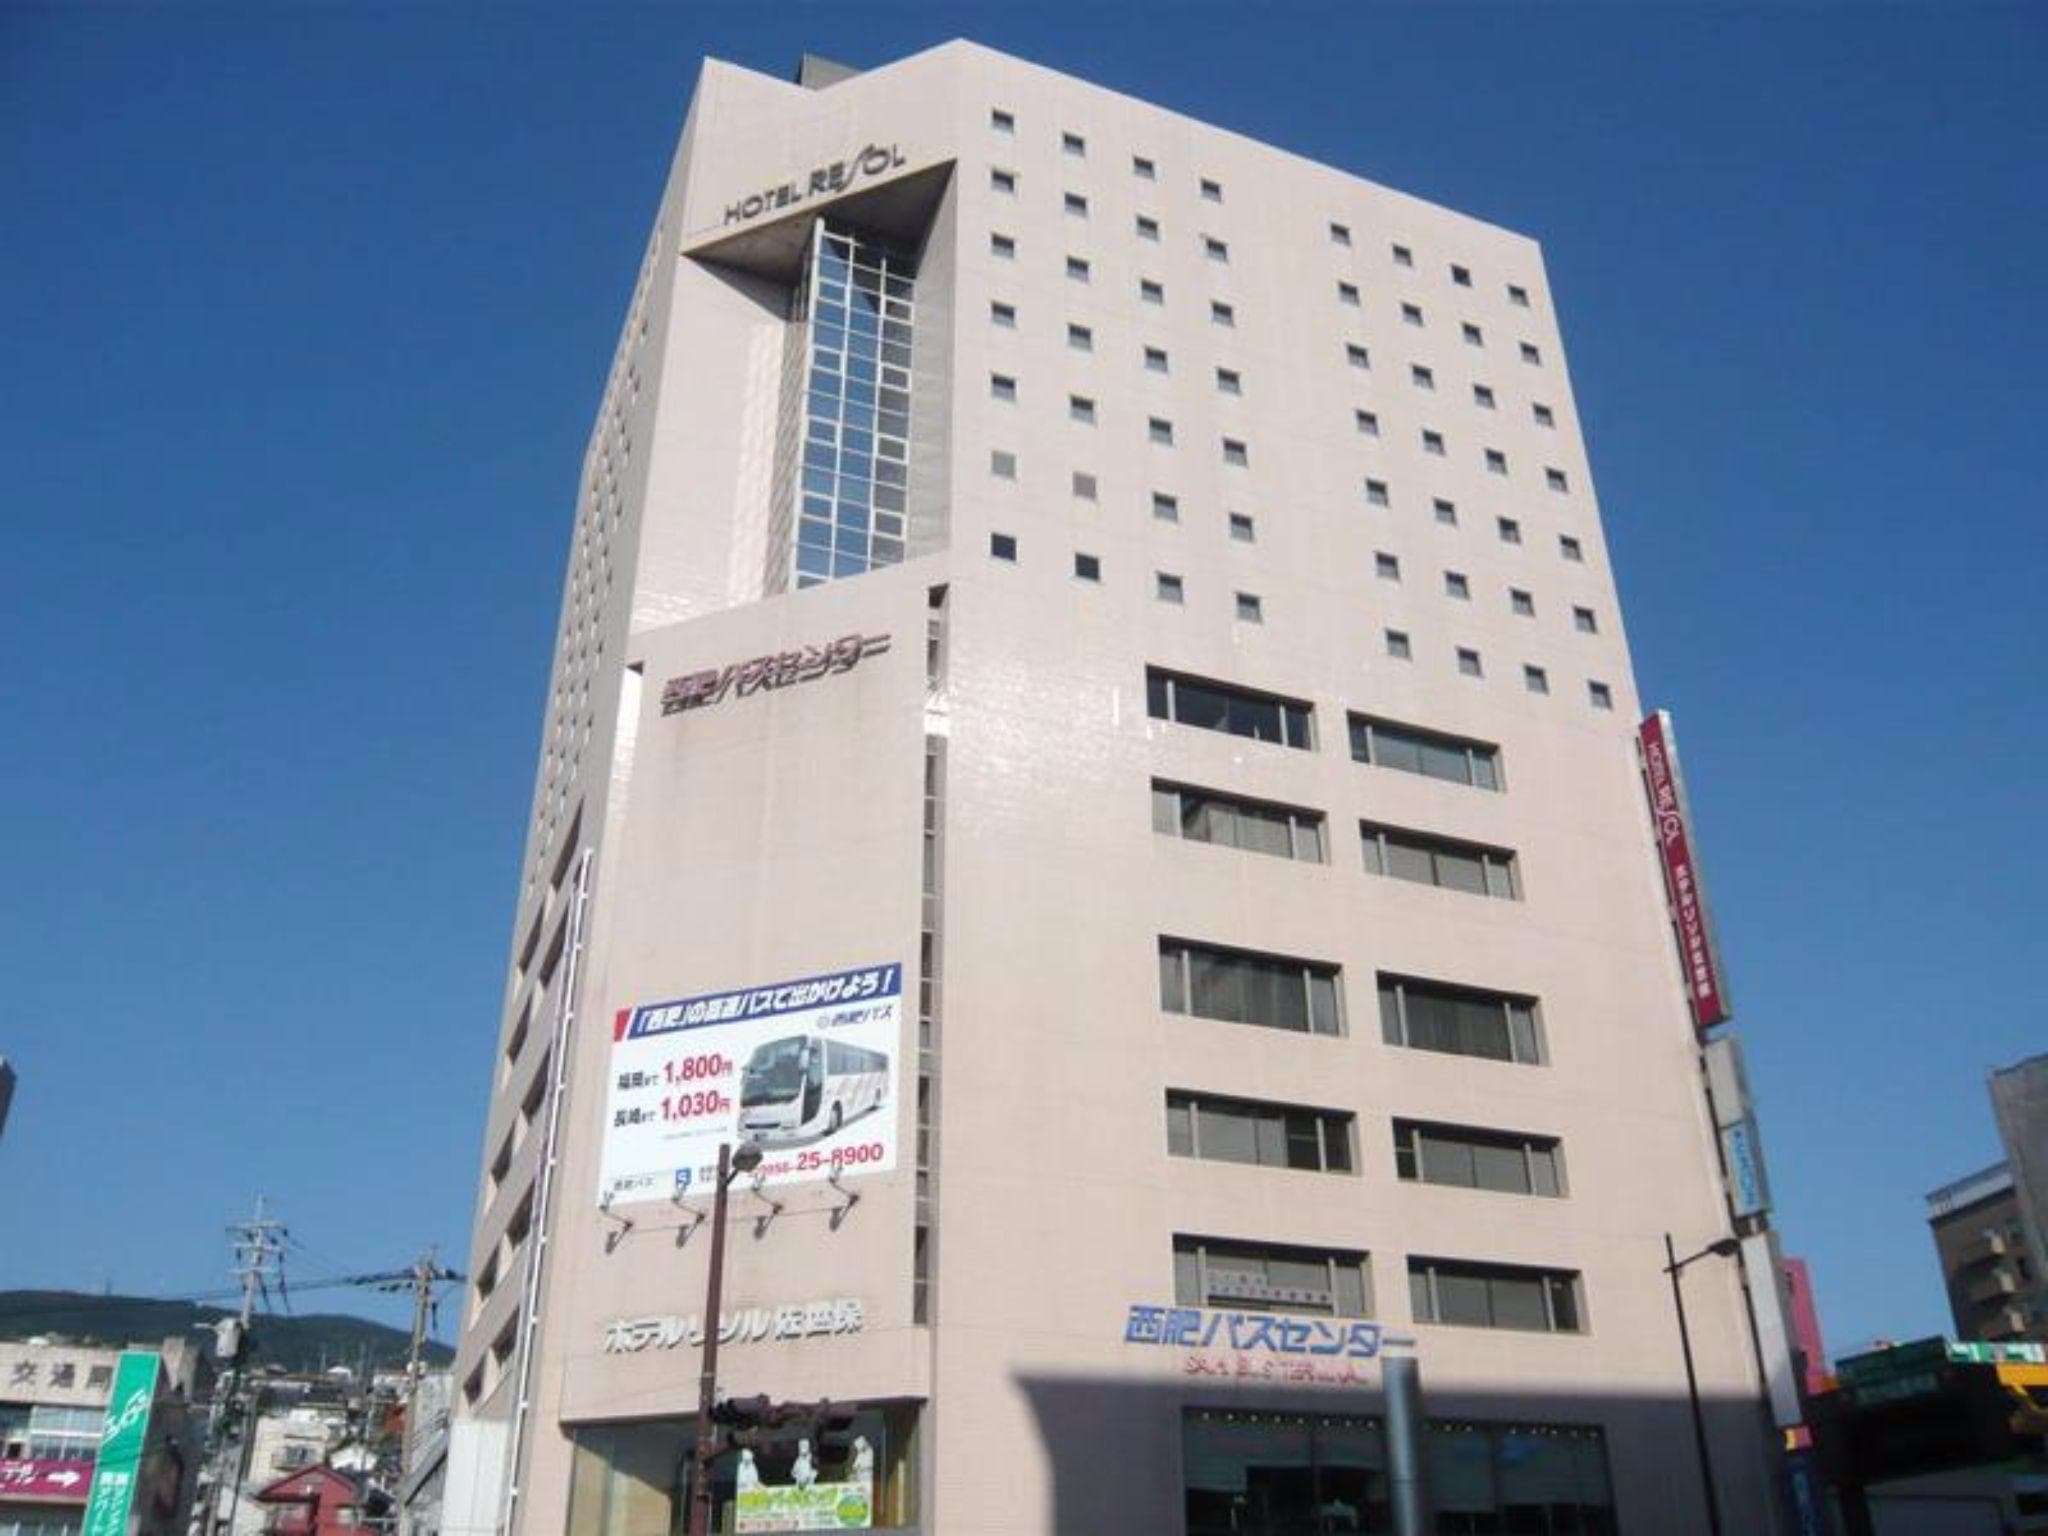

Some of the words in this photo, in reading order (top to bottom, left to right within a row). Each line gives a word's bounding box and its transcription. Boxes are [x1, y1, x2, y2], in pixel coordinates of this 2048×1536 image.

[724, 181, 803, 226] HOTEL
[807, 142, 905, 199] RESOL
[1125, 1305, 1416, 1357] 西肥バスセンター
